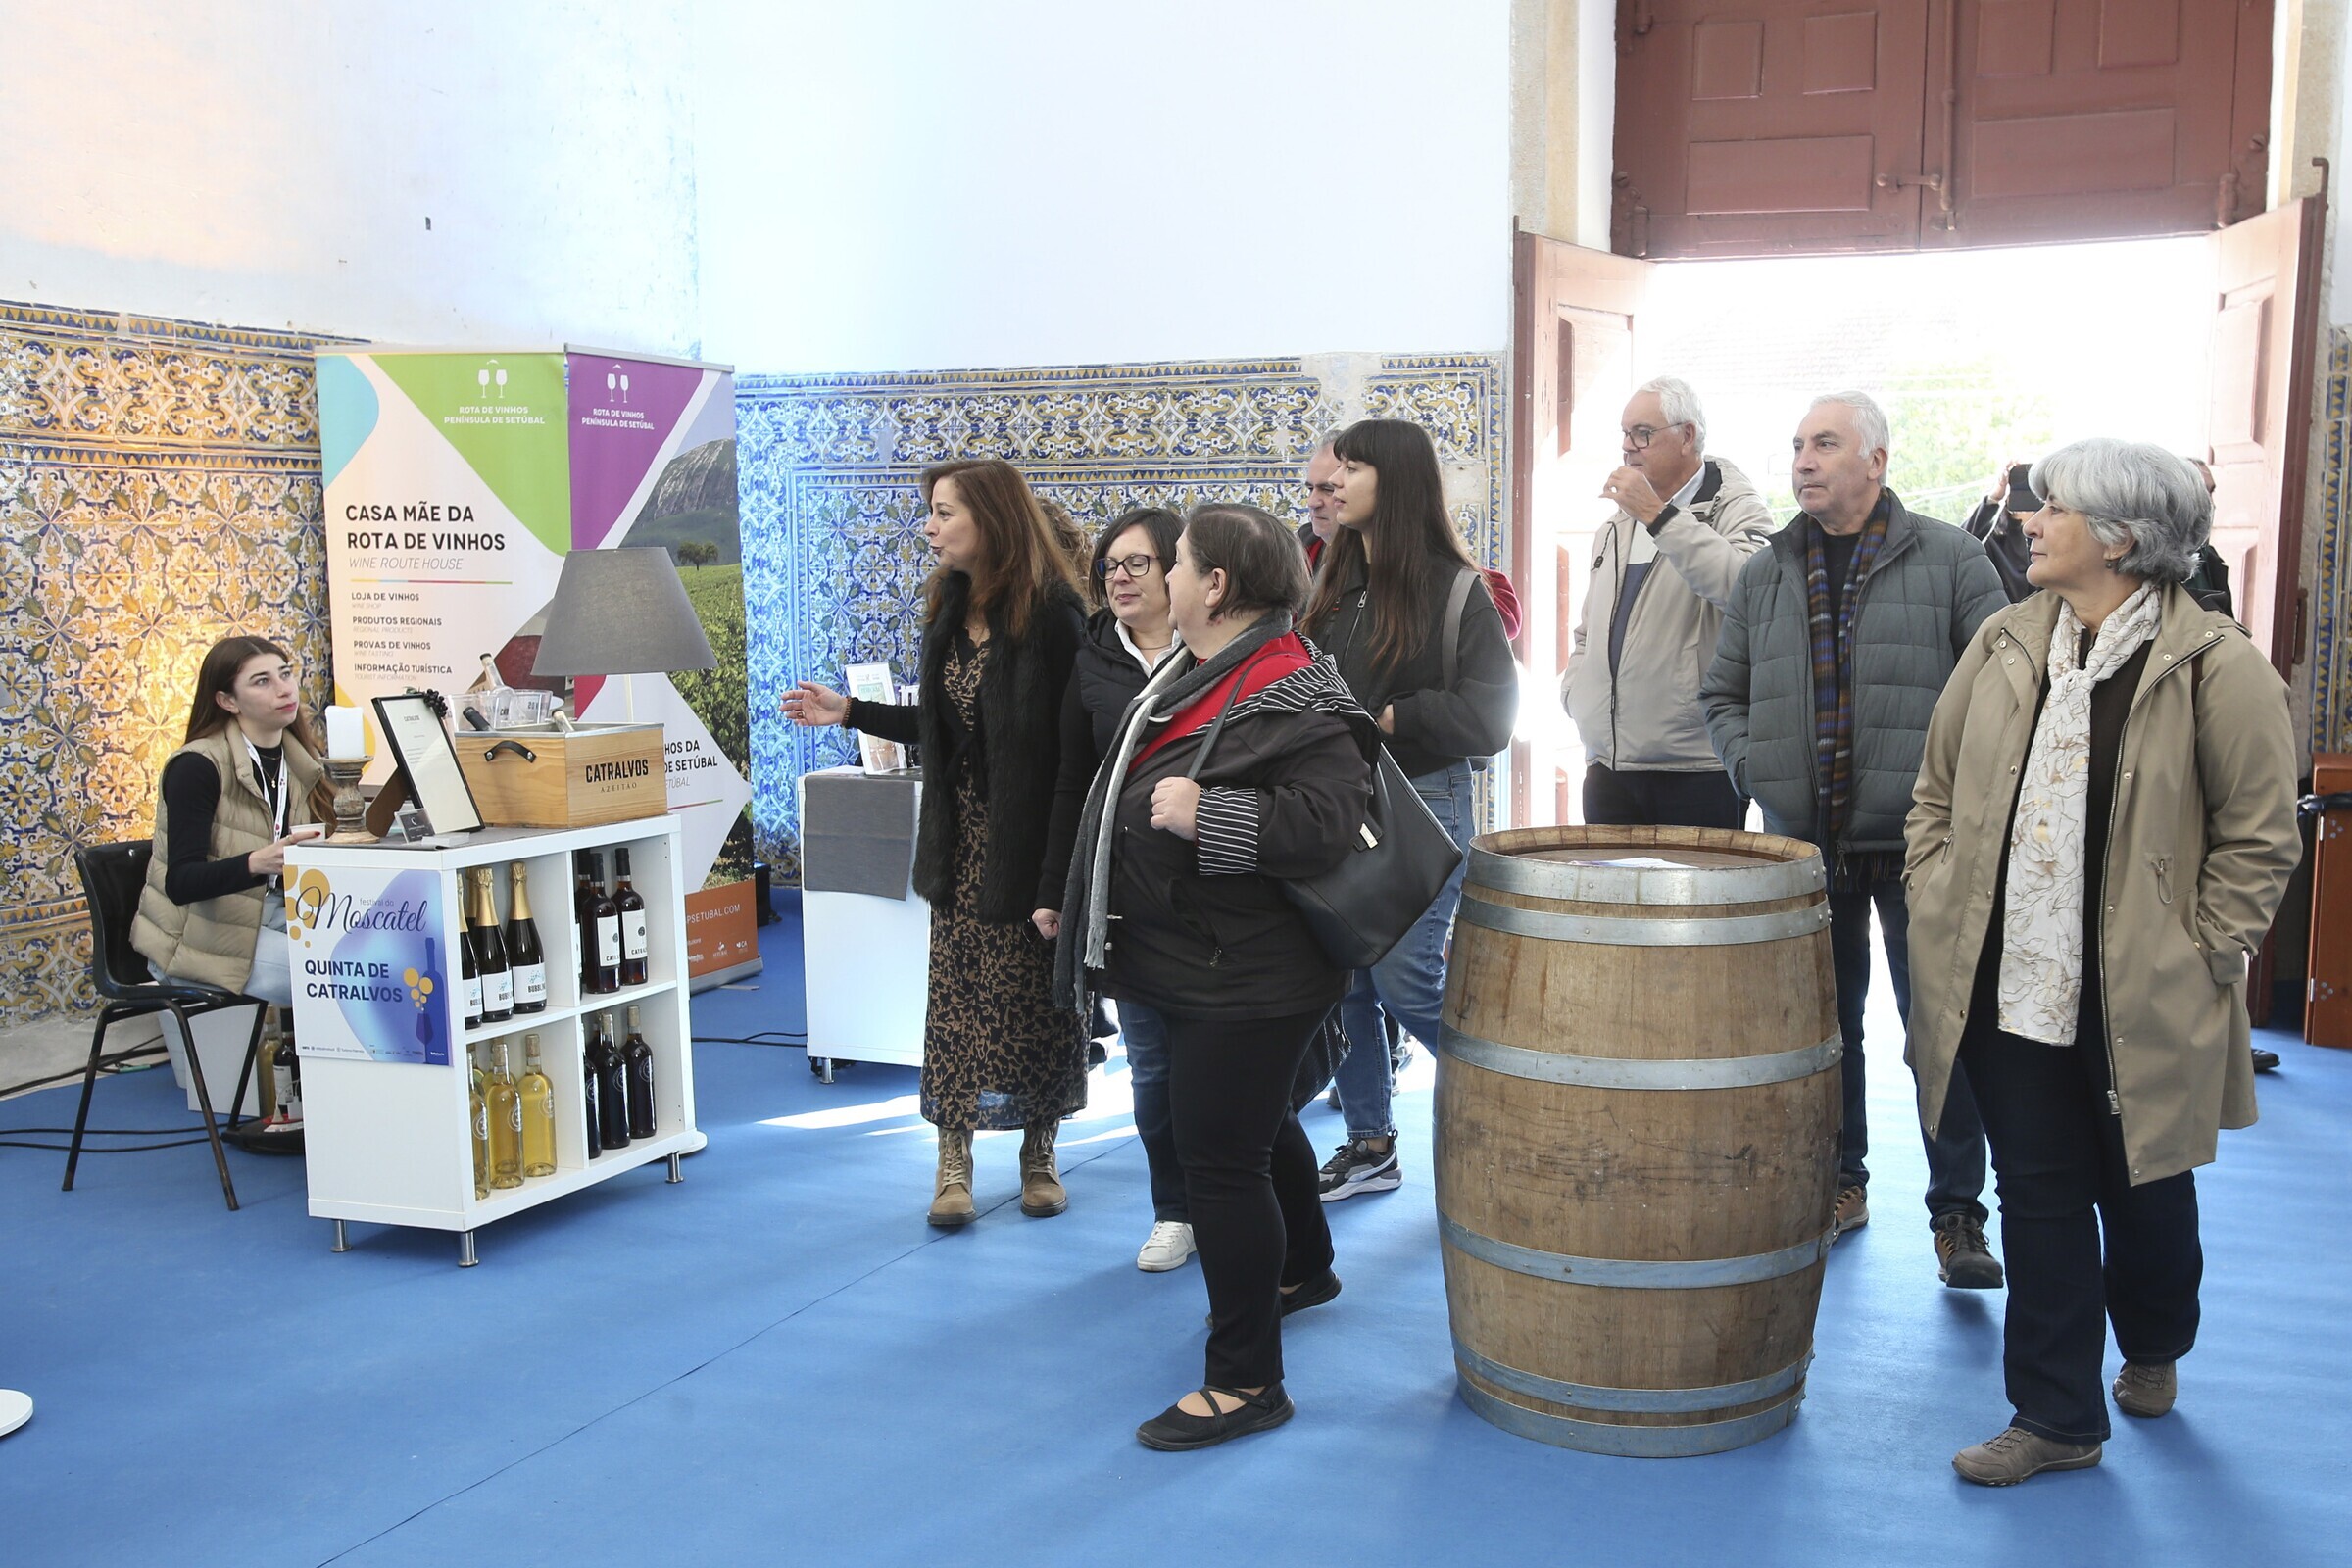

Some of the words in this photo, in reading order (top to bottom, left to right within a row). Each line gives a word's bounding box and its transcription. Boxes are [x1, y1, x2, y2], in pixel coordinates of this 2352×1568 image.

[494, 406, 528, 415] VINHOS
[593, 408, 610, 416] ROTA
[611, 409, 620, 417] DE
[621, 410, 645, 419] VINHOS
[444, 415, 490, 424] PENÍNSULA
[505, 415, 545, 424] SETÚBAL
[581, 416, 619, 427] PENÍNSULA
[619, 419, 628, 428] DE
[628, 419, 655, 430] SETÚBAL
[345, 505, 397, 521] CASA
[403, 500, 441, 521] MÃE
[448, 506, 474, 522] DA
[347, 532, 398, 549] ROTA
[404, 533, 427, 549] DE
[432, 533, 506, 551] VINHOS
[349, 557, 378, 569] WINE
[380, 557, 421, 569] ROUTE
[421, 558, 464, 570] HOUSE
[351, 592, 371, 601] LOJA
[373, 592, 386, 601] DE
[352, 616, 398, 625] PRODUTOS
[400, 617, 442, 626] REGIONAIS
[353, 640, 386, 649] PROVAS
[403, 641, 431, 650] VINHOS
[354, 662, 410, 674] INFORMAÇÃO
[412, 663, 453, 674] TURÍSTICA
[664, 742, 683, 755] HOS
[686, 740, 700, 753] DA
[675, 755, 718, 771] SETÚBAL
[585, 759, 649, 783] CATRALVOS
[666, 777, 690, 790] ETÚBAL
[360, 898, 383, 906] festival
[385, 898, 394, 906] do
[295, 885, 428, 934] Moscatel
[686, 904, 741, 924] PSETUBAL.COM
[305, 959, 365, 977] QUINTA
[368, 963, 389, 978] DE
[306, 983, 403, 1003] CATRALVOS
